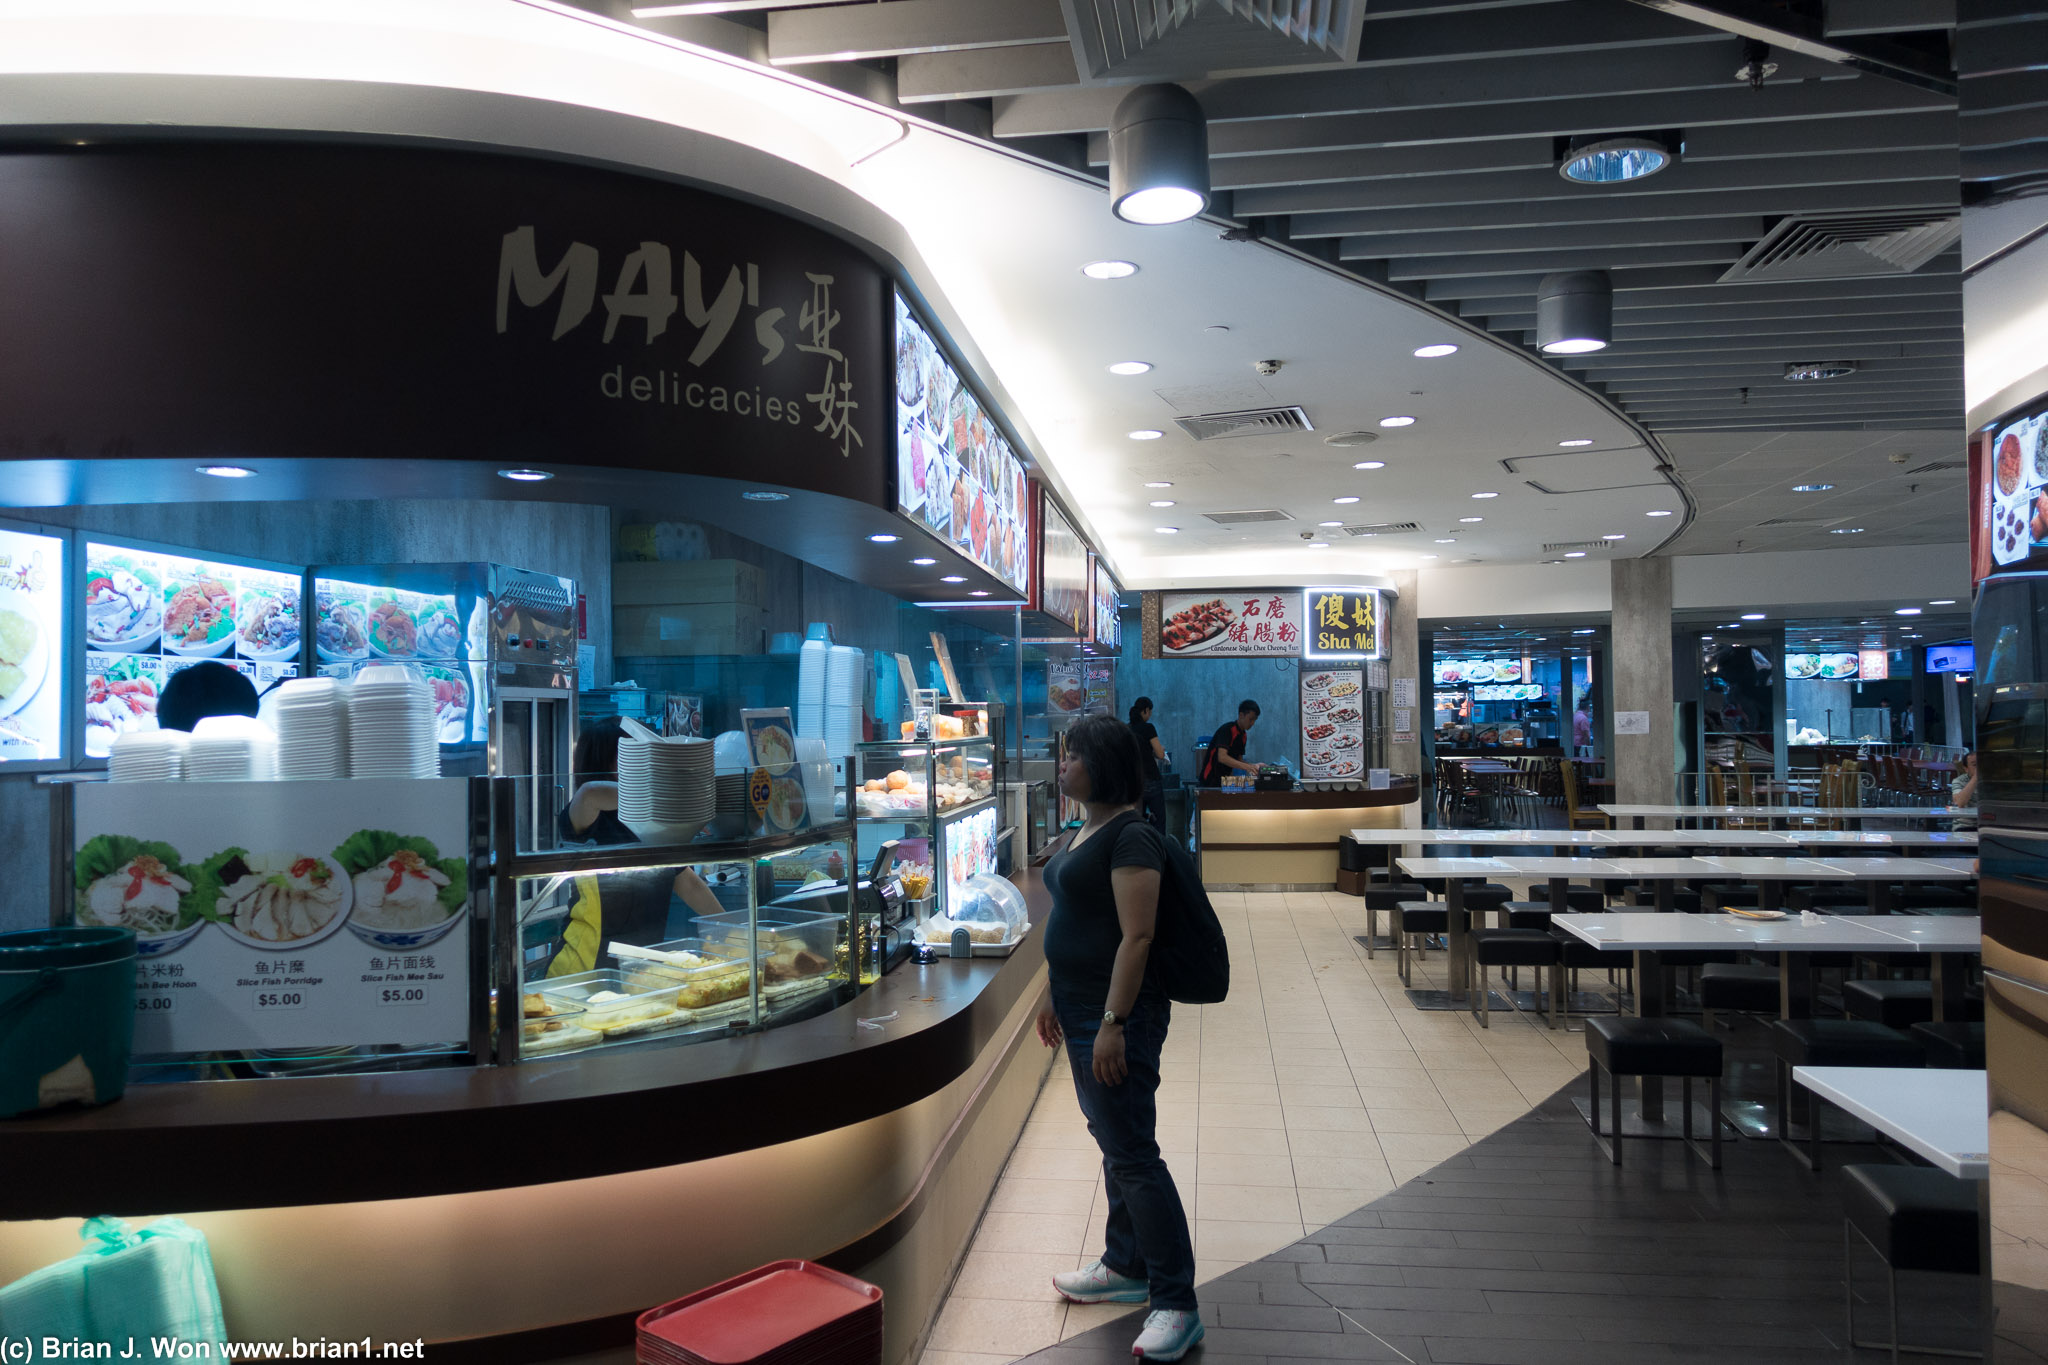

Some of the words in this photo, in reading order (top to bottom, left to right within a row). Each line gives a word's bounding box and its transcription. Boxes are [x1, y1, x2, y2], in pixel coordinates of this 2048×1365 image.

[496, 224, 786, 367] MAY's
[795, 270, 864, 458] 亚妹
[600, 364, 801, 425] delicacies
[1242, 595, 1286, 619] 石磨
[1314, 592, 1376, 631] 傻妹
[1253, 644, 1266, 652] Chee
[1267, 644, 1287, 652] Cheong
[1318, 632, 1351, 649] Sha
[1354, 632, 1374, 650] Mei
[141, 661, 157, 669] $8.00
[136, 963, 184, 978] 片米粉
[369, 955, 436, 971] 鱼片面线
[236, 978, 259, 987] Slice
[261, 978, 281, 986] Fish
[284, 977, 323, 986] Porridge
[361, 974, 383, 982] Slice
[385, 974, 404, 982] Fish
[406, 973, 424, 981] Mee
[426, 972, 444, 980] Sau
[136, 981, 149, 990] ish
[152, 981, 170, 989] Bee
[172, 981, 197, 989] Hoon
[258, 993, 302, 1007] $5.00
[382, 988, 424, 1002] $5.00
